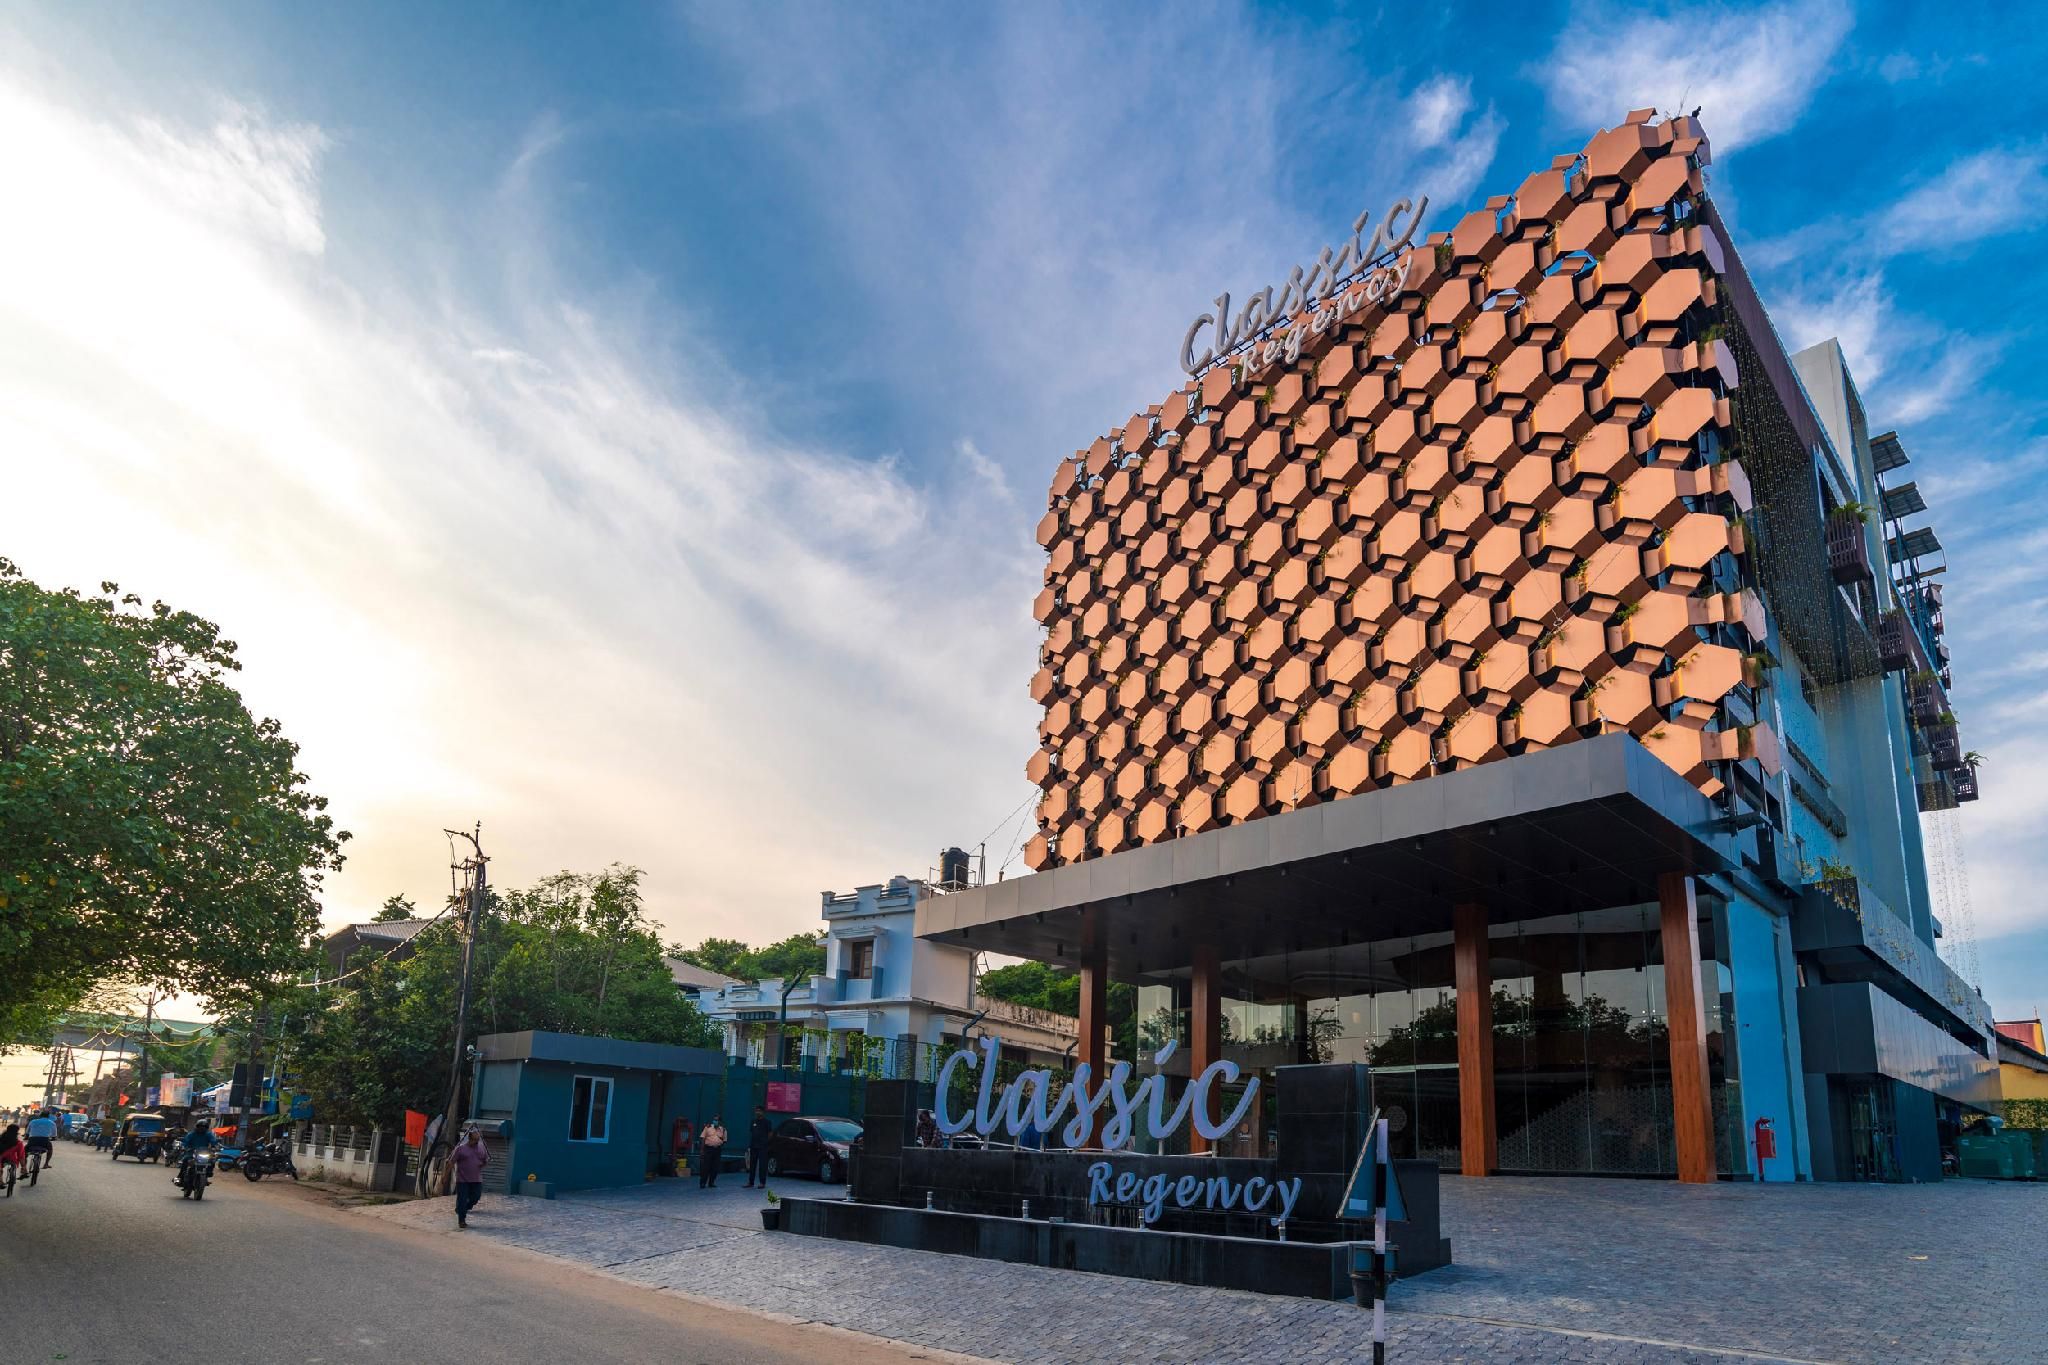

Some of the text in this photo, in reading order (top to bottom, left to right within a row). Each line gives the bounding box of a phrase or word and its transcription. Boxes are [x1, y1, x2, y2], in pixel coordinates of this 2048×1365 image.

[1180, 193, 1429, 376] Classic
[1241, 254, 1412, 382] Regency
[935, 1036, 1261, 1150] Classic
[1087, 1161, 1301, 1226] Regency
